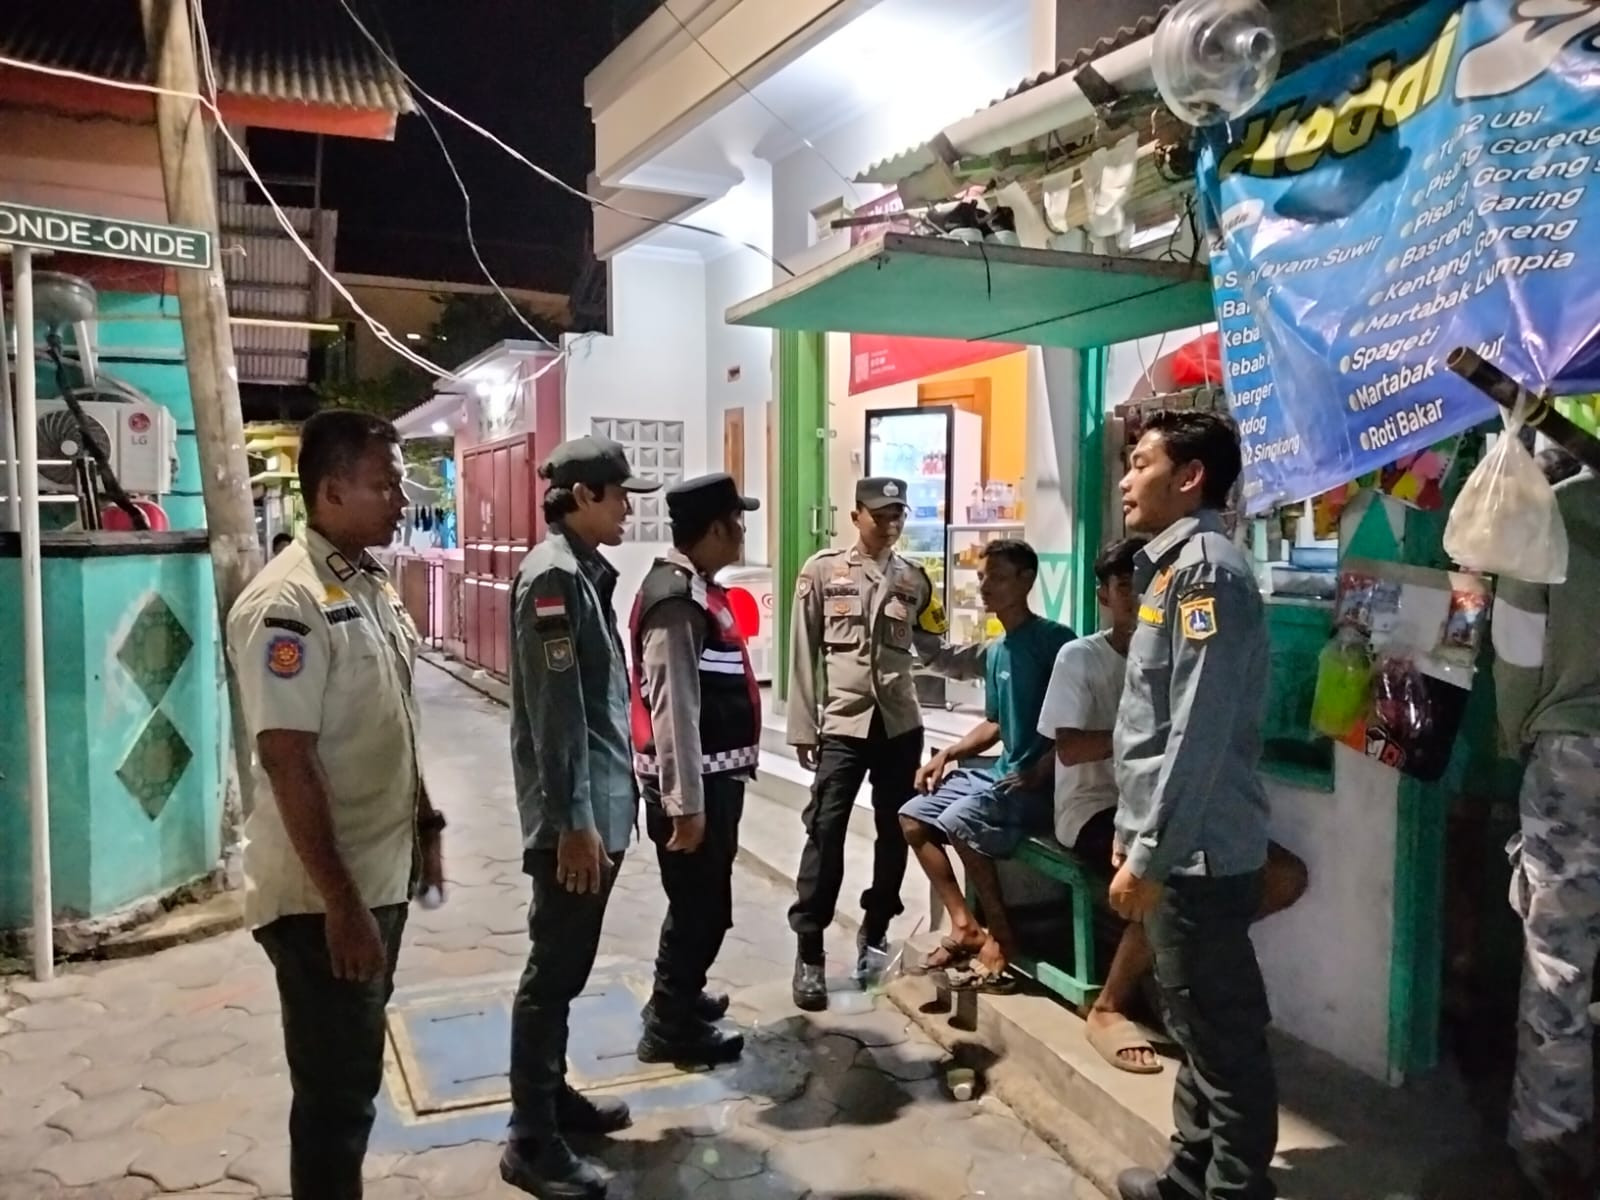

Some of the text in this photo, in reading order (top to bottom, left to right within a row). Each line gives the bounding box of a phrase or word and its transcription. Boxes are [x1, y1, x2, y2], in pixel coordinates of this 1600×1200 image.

[1490, 105, 1545, 129] Ubi
[1413, 156, 1591, 233] Pisang Goreng
[0, 210, 196, 260] ONDE-ONDE
[1322, 235, 1383, 267] Suwir
[1400, 186, 1586, 268] Basreng Garing
[1384, 219, 1578, 301] Kentang Goreng
[1365, 249, 1576, 334] Martabak Lumpia
[1351, 325, 1440, 371] Spageti
[1357, 356, 1438, 410] Martabak
[1253, 433, 1300, 463] Singkong
[1368, 398, 1443, 450] Roti Bakar
